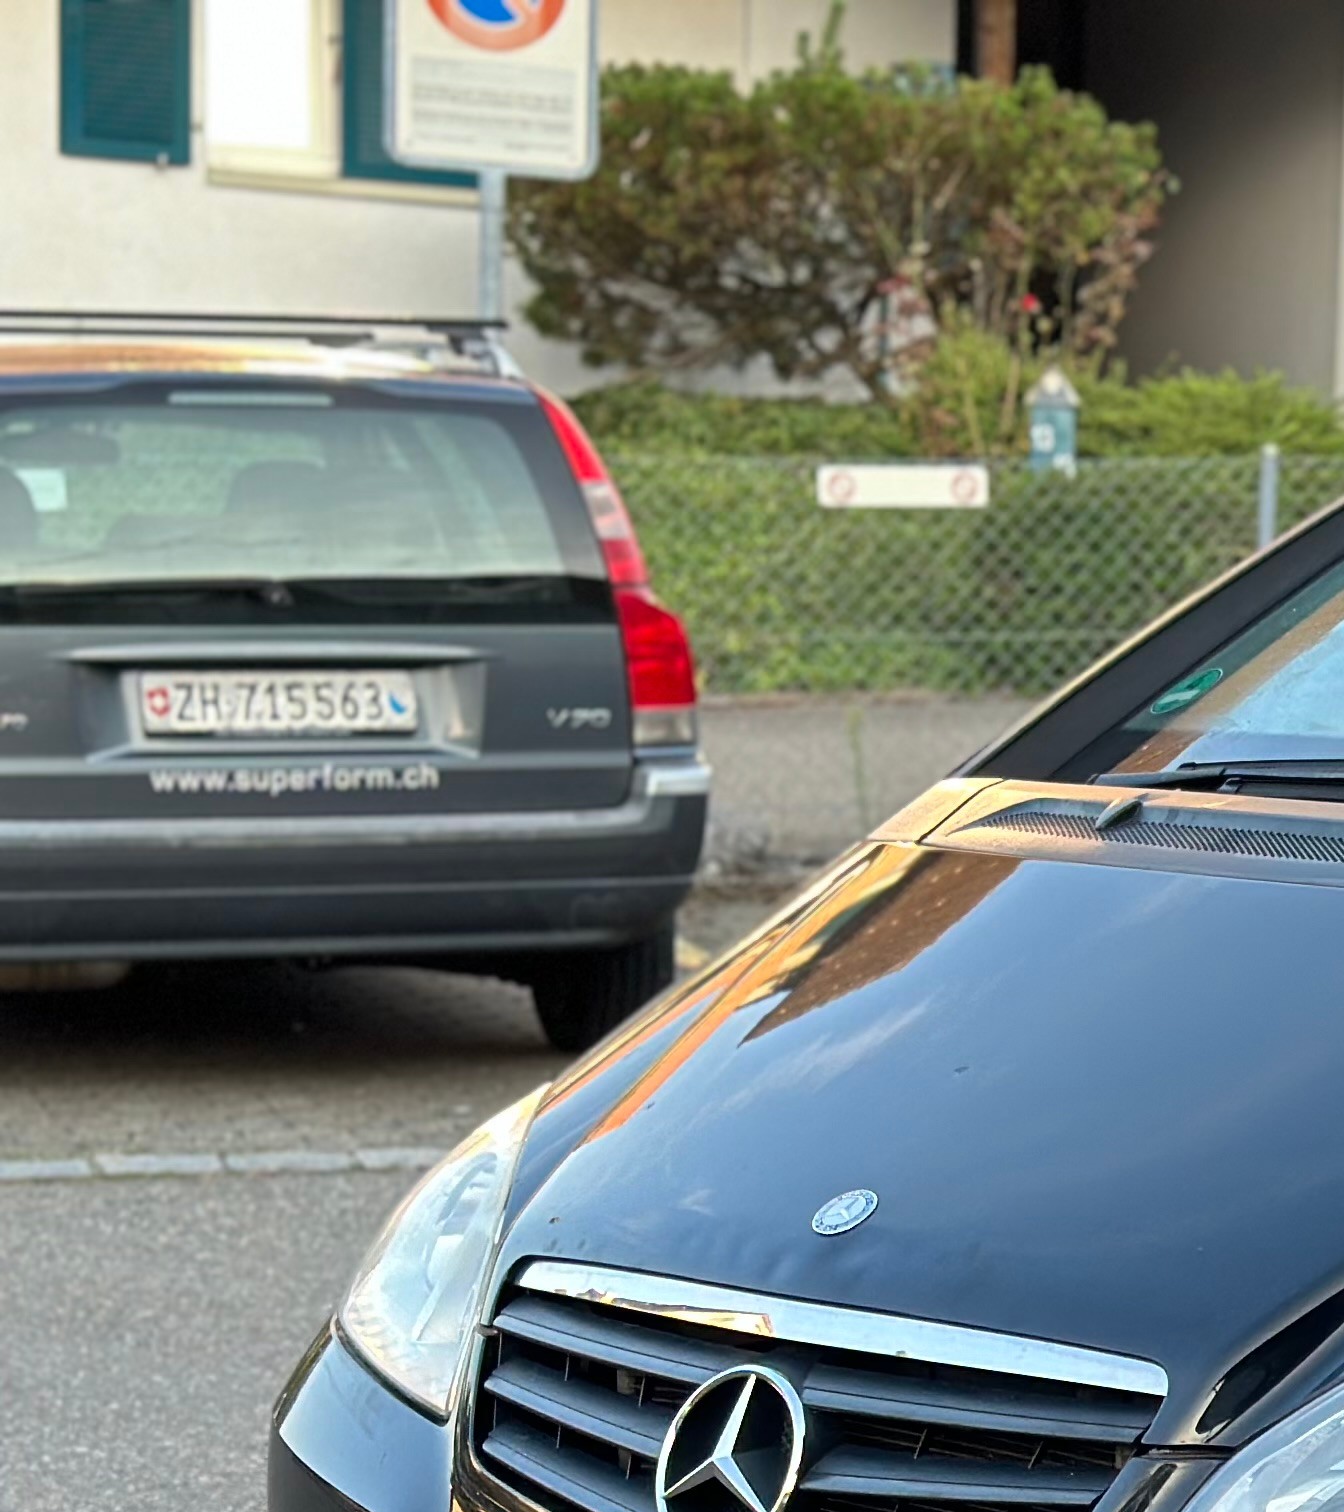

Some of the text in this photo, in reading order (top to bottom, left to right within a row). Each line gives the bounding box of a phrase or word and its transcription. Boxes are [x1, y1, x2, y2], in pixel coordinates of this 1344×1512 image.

[174, 681, 385, 721] ZH 715563
[545, 706, 612, 730] V70
[150, 762, 440, 796] www.superform.ch
